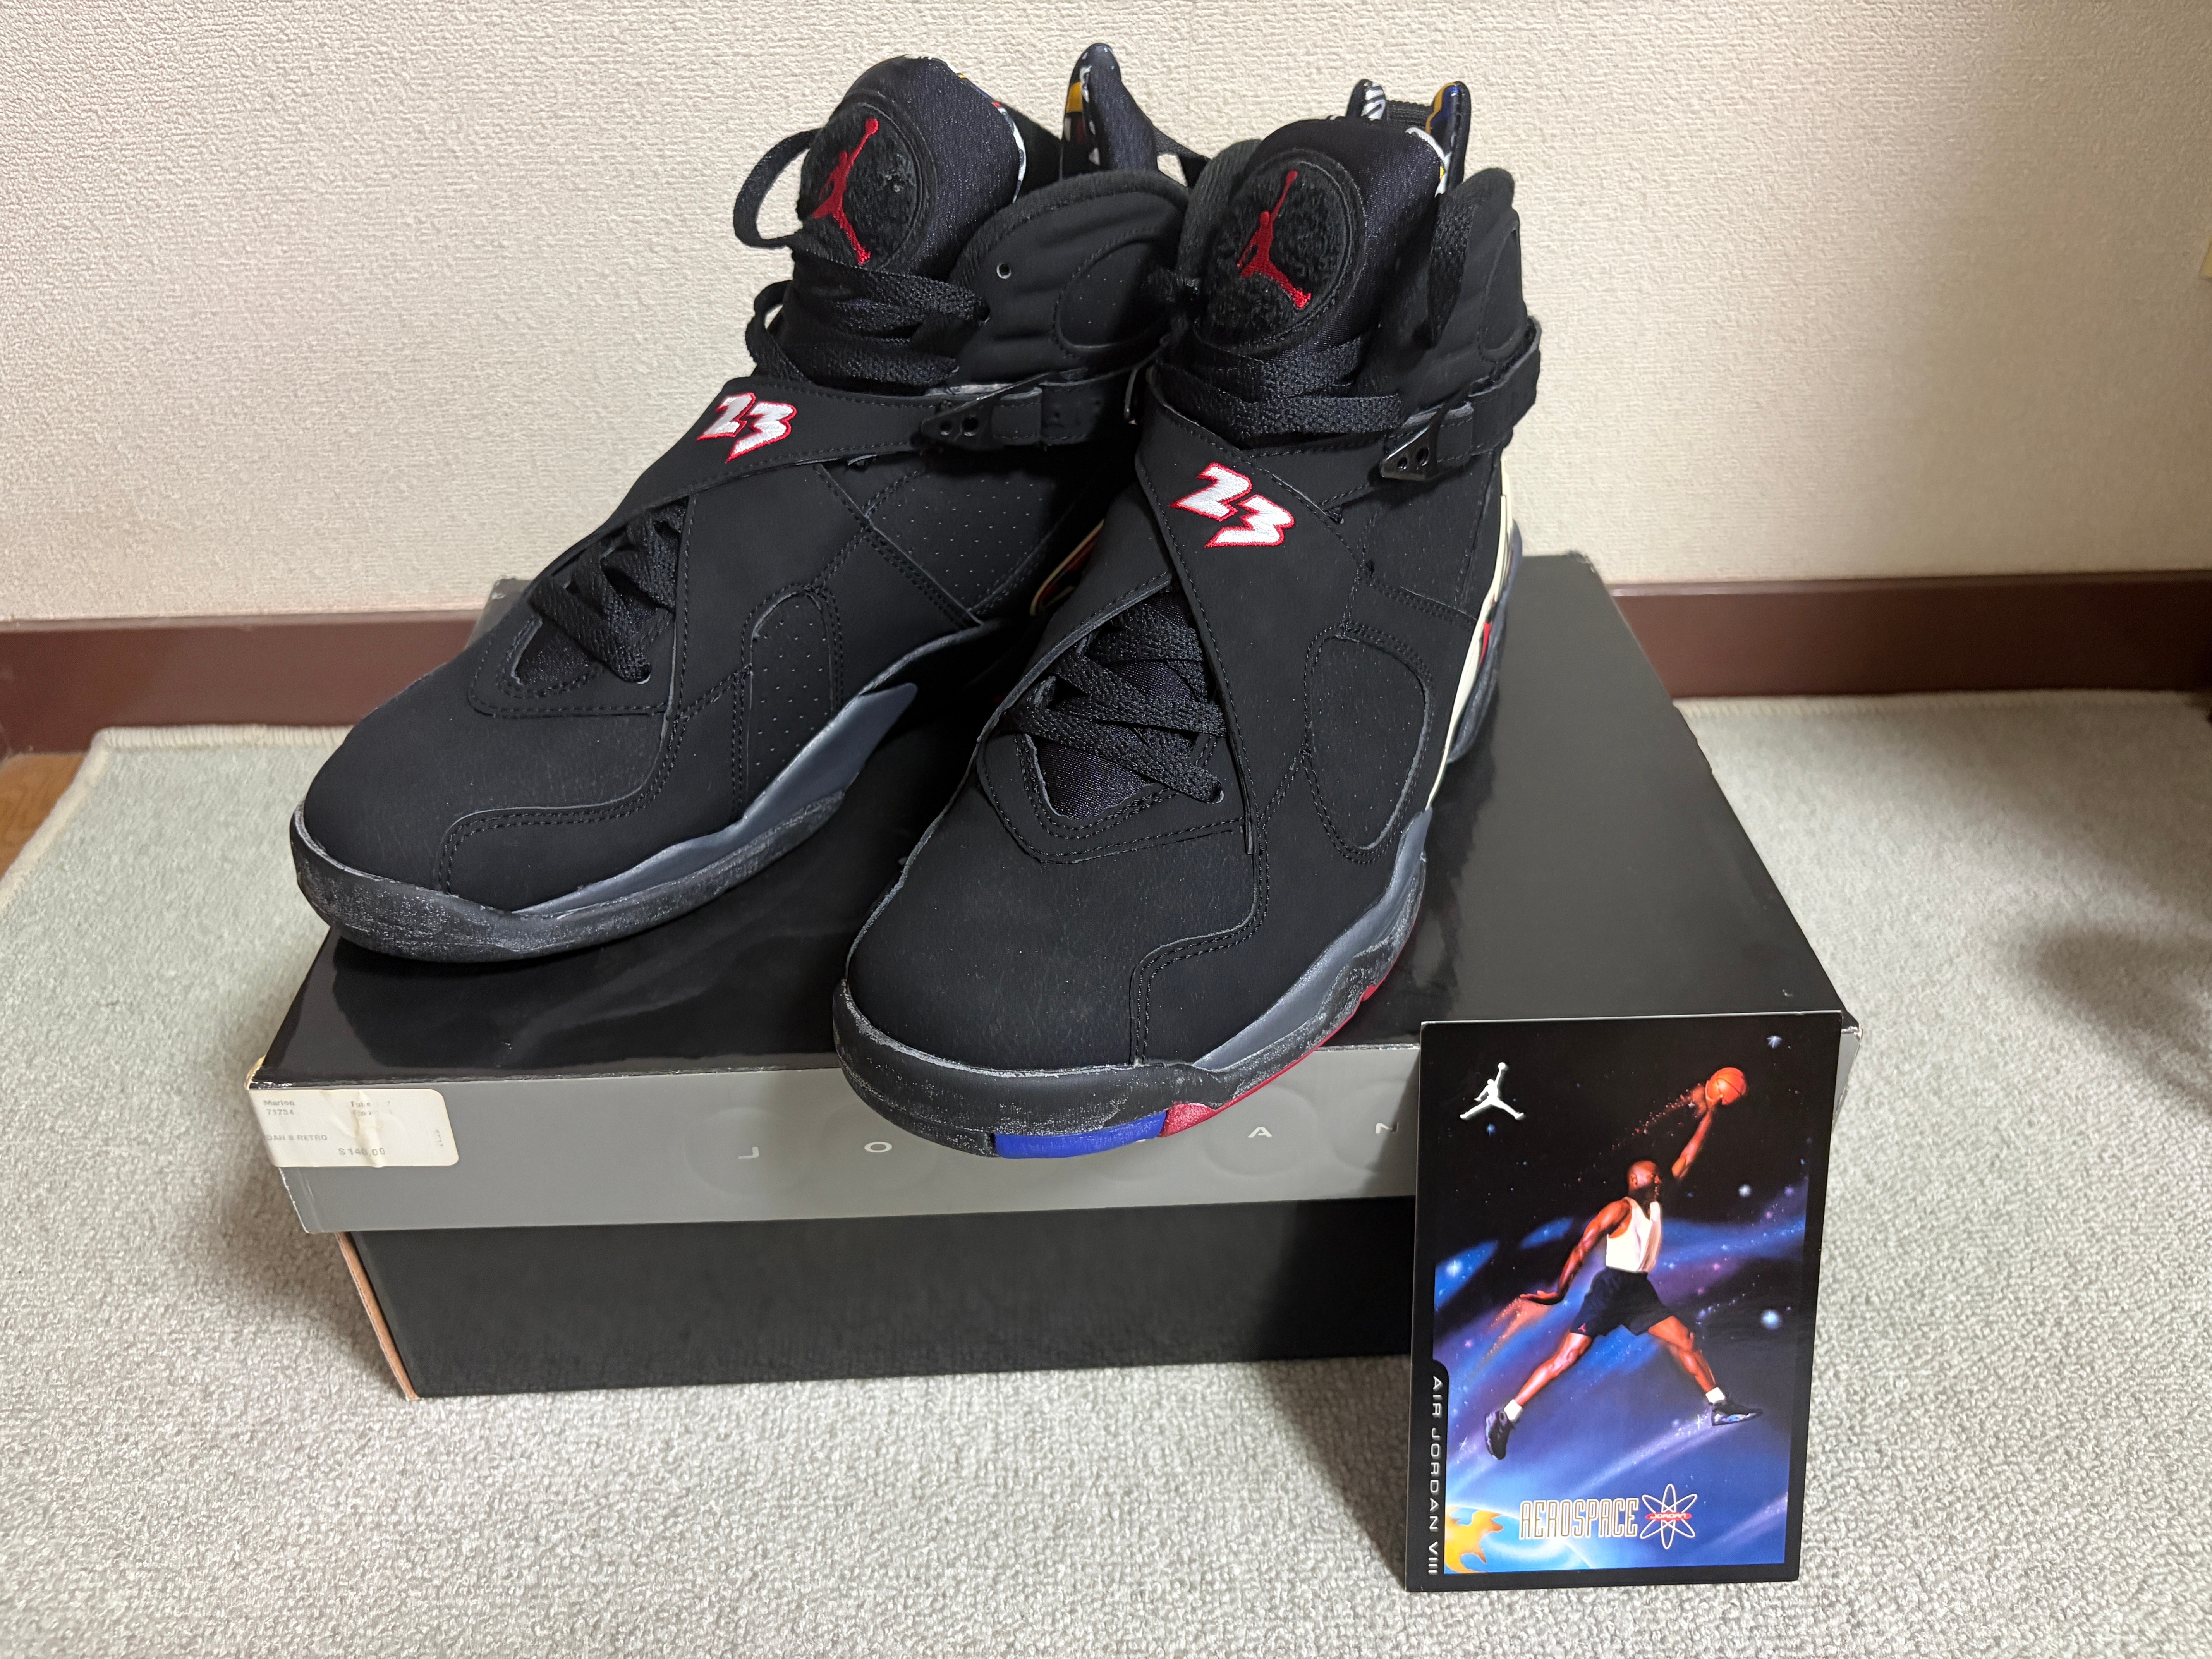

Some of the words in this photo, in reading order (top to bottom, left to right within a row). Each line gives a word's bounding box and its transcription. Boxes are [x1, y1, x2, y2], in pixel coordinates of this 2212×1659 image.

[696, 392, 797, 464] 23
[1168, 462, 1295, 548] 23
[1433, 1376, 1443, 1419] AIR
[1430, 1427, 1441, 1532] JORDAN
[1518, 1498, 1639, 1540] AEROSPACE
[1428, 1541, 1438, 1575] VIII
